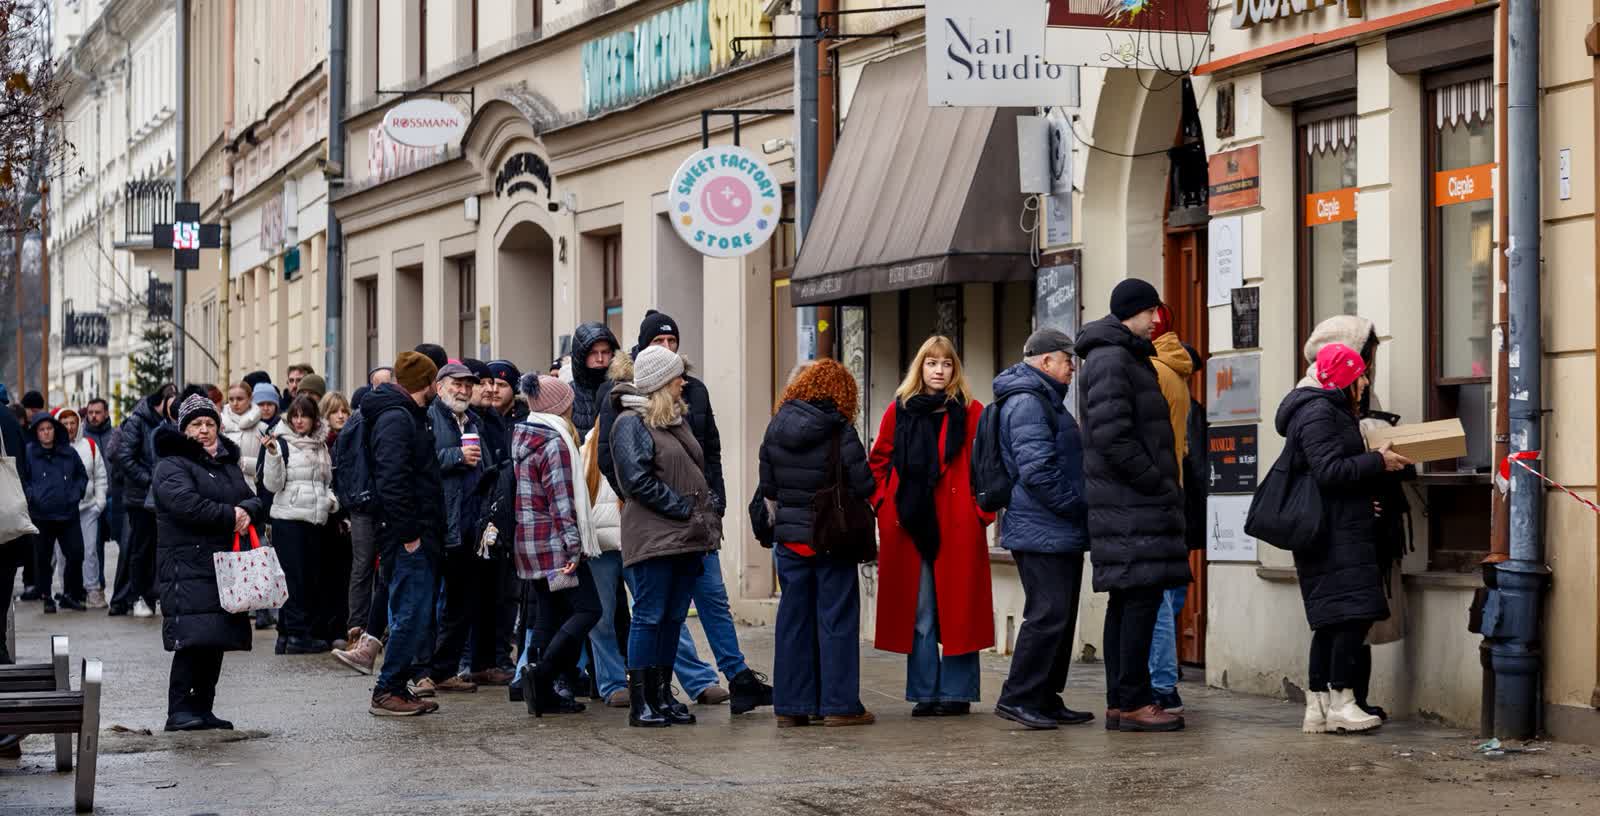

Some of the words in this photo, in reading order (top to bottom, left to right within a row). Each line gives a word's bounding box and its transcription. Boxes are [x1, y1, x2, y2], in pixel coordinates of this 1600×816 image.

[945, 17, 1012, 54] Nail
[581, 32, 634, 118] SWEET
[634, 0, 709, 96] FACTORY
[947, 43, 1062, 80] Studio
[392, 118, 459, 129] ROSSMANN
[677, 156, 716, 196] SWEET
[720, 154, 776, 198] FACTORY
[694, 230, 753, 249] STORE
